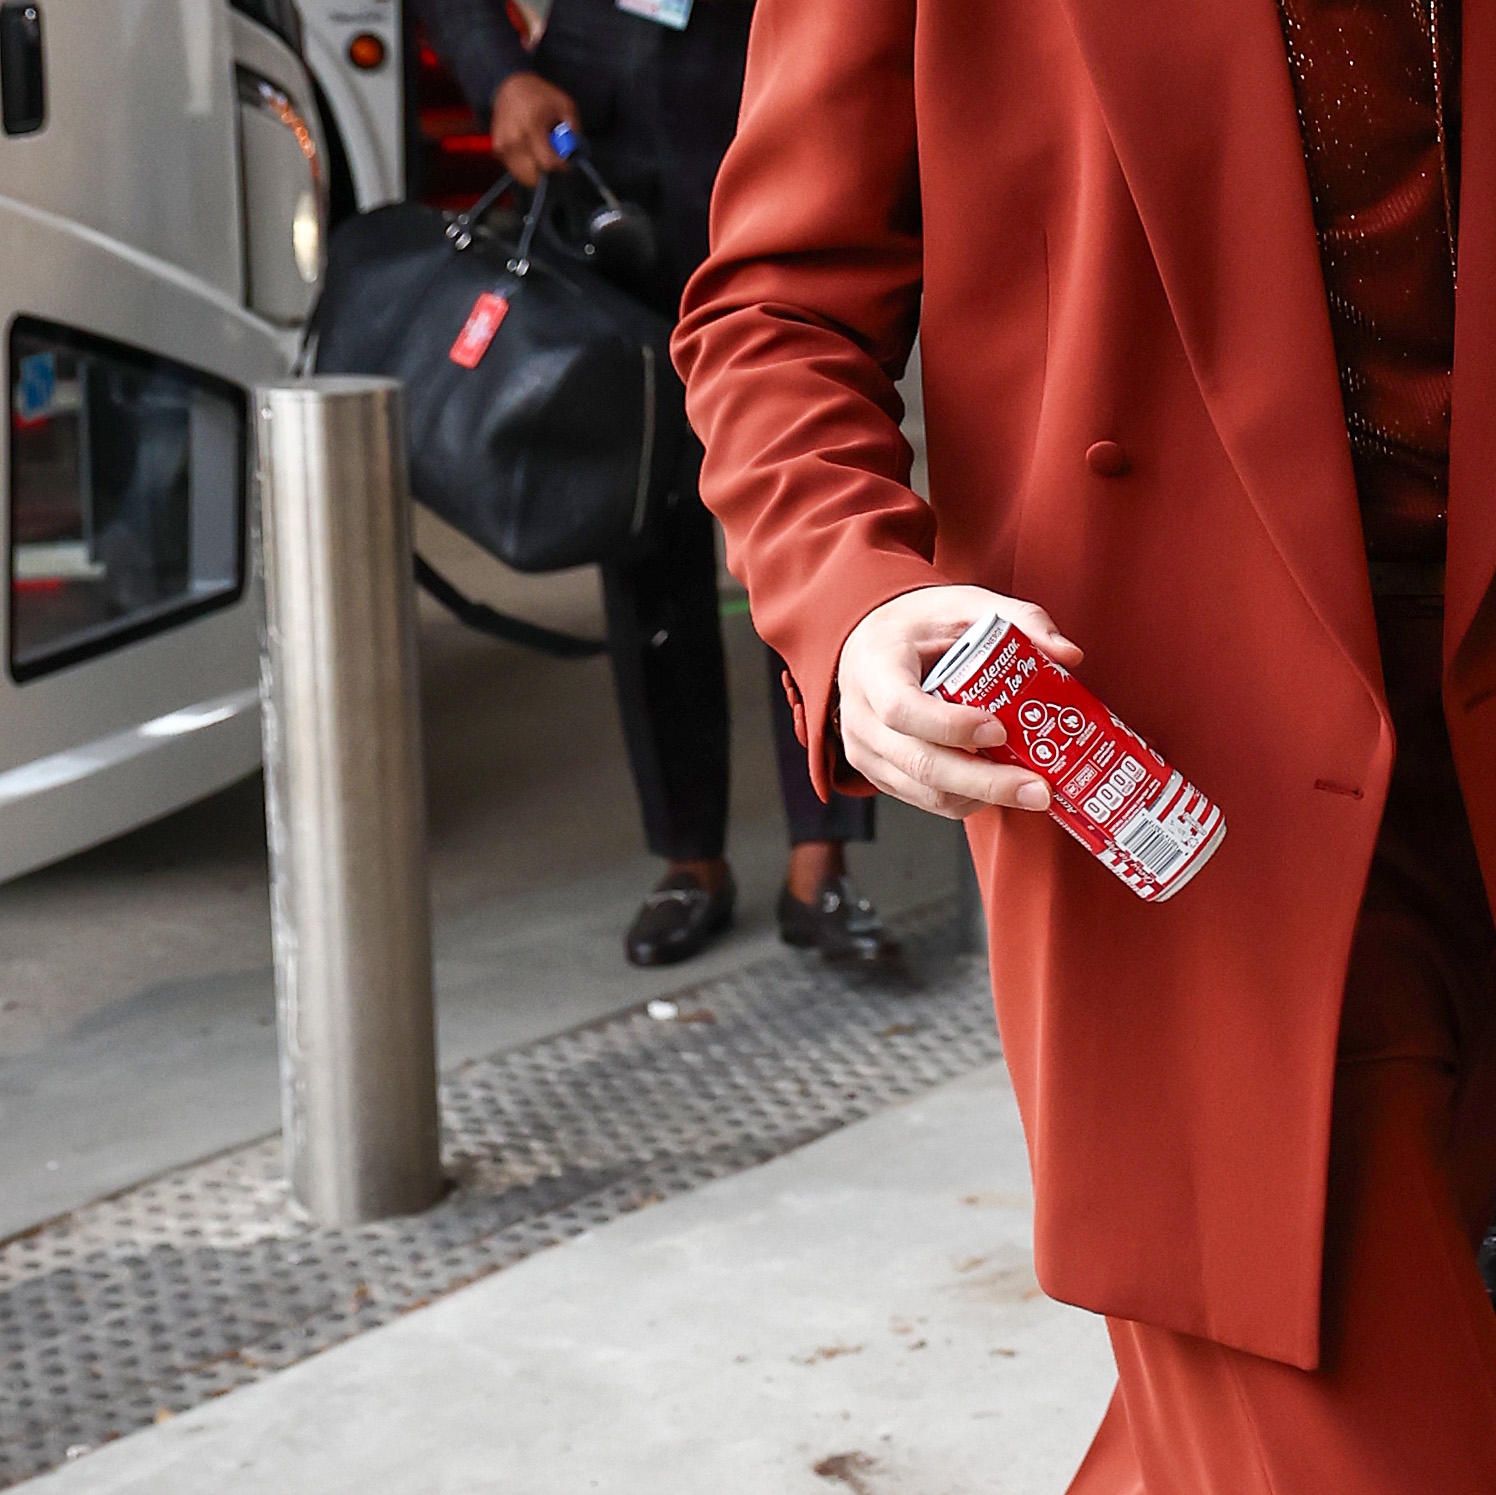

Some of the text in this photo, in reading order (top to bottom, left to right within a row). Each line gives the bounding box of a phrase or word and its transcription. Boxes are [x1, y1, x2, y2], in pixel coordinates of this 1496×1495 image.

[983, 627, 1003, 650] ENERGY
[977, 678, 999, 700] ACTIVE
[1004, 674, 1023, 695] Ice
[1016, 656, 1037, 677] Pop
[1088, 801, 1100, 813] 0
[1100, 788, 1112, 800] 0
[1113, 773, 1125, 785] 0
[1125, 760, 1136, 771] 0
